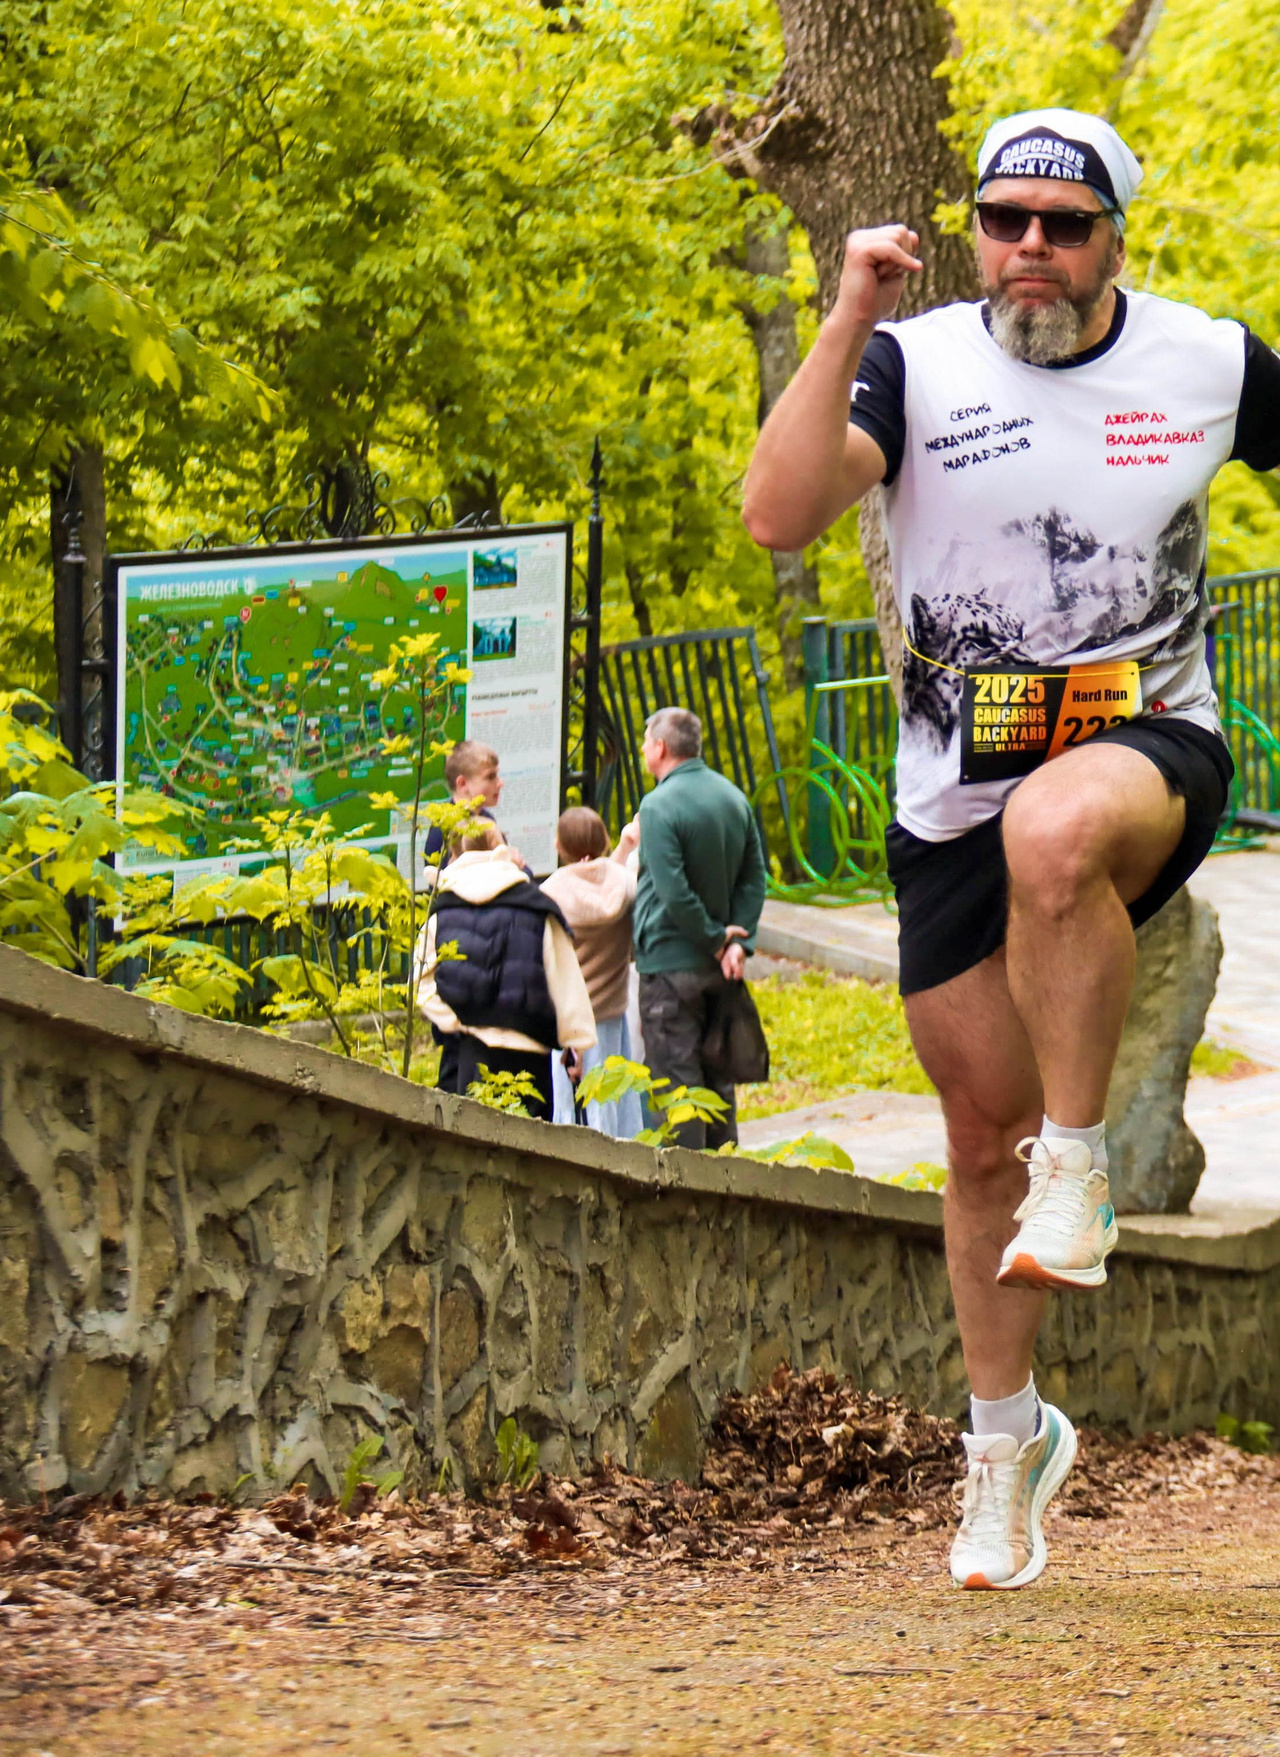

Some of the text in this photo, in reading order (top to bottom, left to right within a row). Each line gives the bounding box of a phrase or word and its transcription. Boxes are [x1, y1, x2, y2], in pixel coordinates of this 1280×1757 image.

[1001, 138, 1085, 169] CAUCASUS
[950, 402, 992, 422] СЕРИЯ
[1104, 411, 1168, 426] ДЖЕЙРАХ
[1106, 430, 1205, 447] ВЛАДИКАВКАЗ
[1106, 454, 1170, 467] НАЛЬЧИК
[141, 578, 239, 602] ЖЕЛЕЗНОВОДСК
[974, 676, 1046, 703] 2025
[1072, 688, 1128, 703] Hard Run
[974, 708, 1046, 723] CAUCASUS
[973, 725, 1046, 742] BACKYARD
[995, 742, 1026, 752] ULTRA
